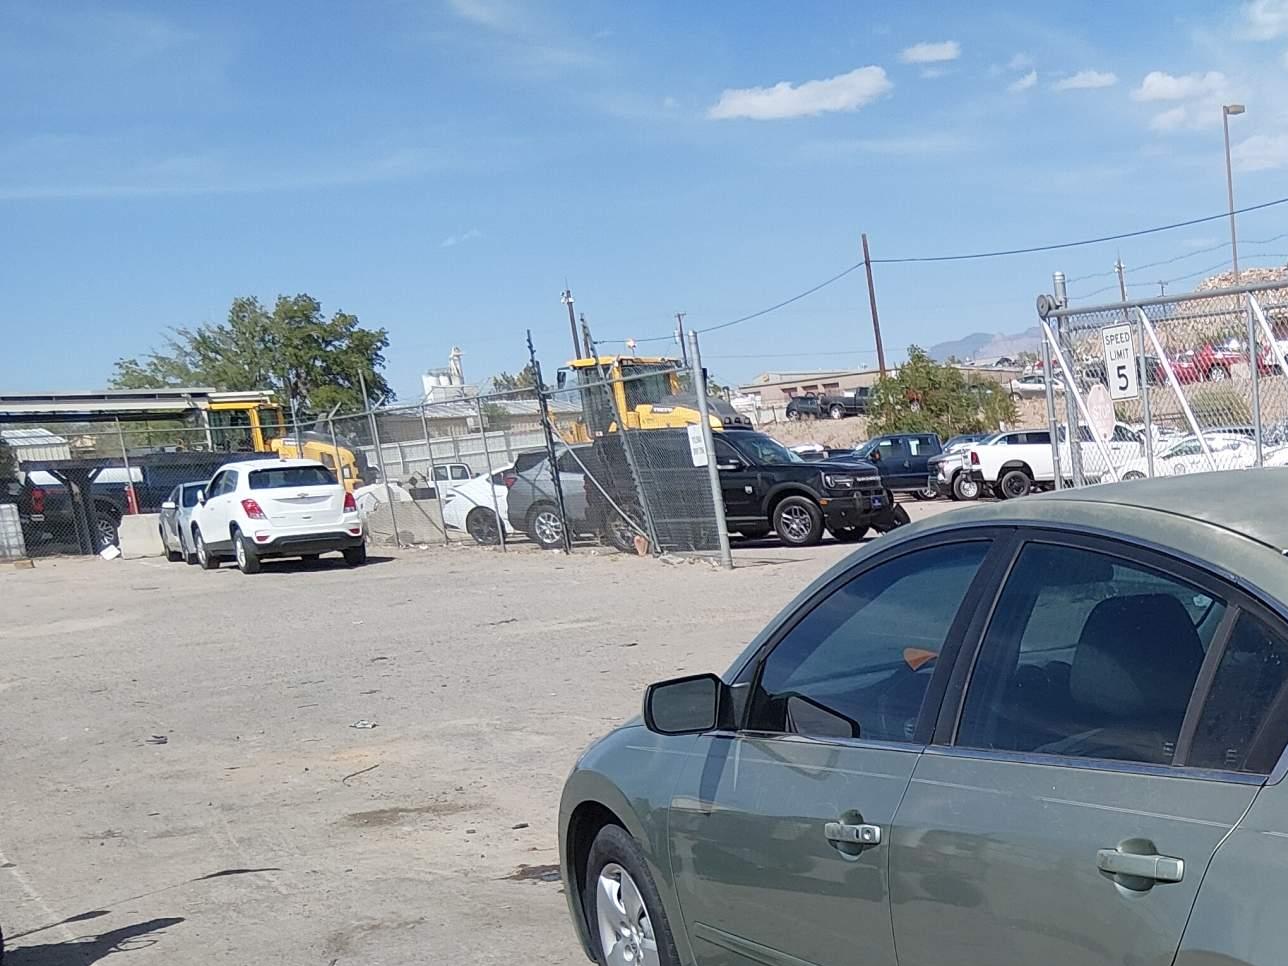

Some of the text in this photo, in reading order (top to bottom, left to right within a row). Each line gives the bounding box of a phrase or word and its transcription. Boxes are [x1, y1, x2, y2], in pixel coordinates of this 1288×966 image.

[1105, 332, 1130, 346] SPEED
[1110, 348, 1129, 361] LIMIT
[1117, 365, 1129, 391] 5
